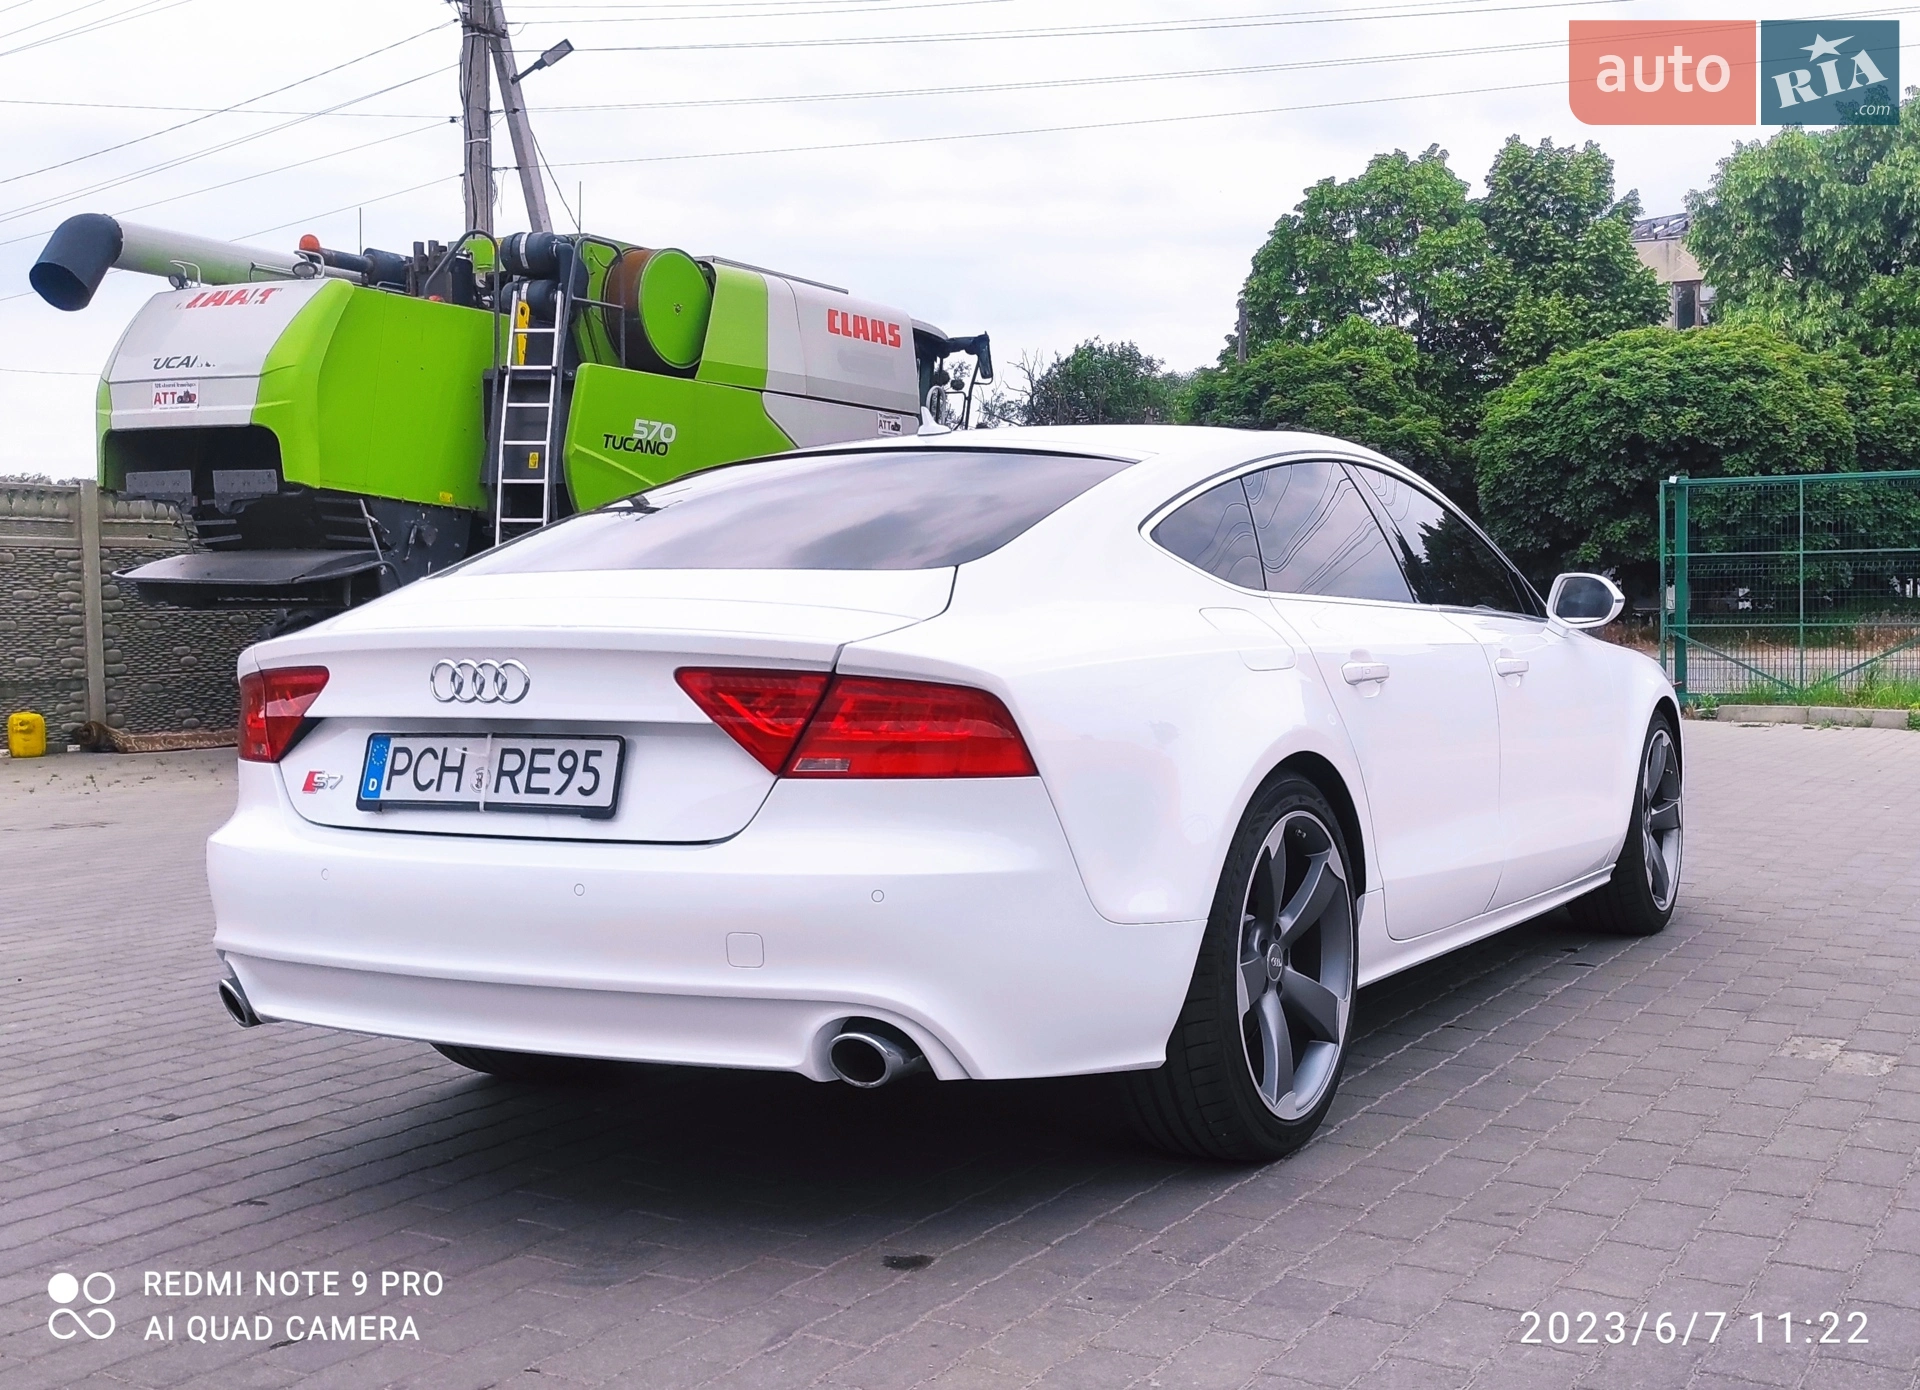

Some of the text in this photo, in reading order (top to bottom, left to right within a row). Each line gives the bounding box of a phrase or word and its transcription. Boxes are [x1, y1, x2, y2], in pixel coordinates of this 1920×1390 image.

[827, 308, 901, 348] CLAAS
[153, 355, 216, 370] UCA
[153, 391, 177, 405] ATT
[632, 418, 677, 443] 570
[603, 433, 669, 456] TUCANO
[385, 746, 468, 793] PCH
[494, 747, 603, 797] RE95
[368, 778, 378, 791] D
